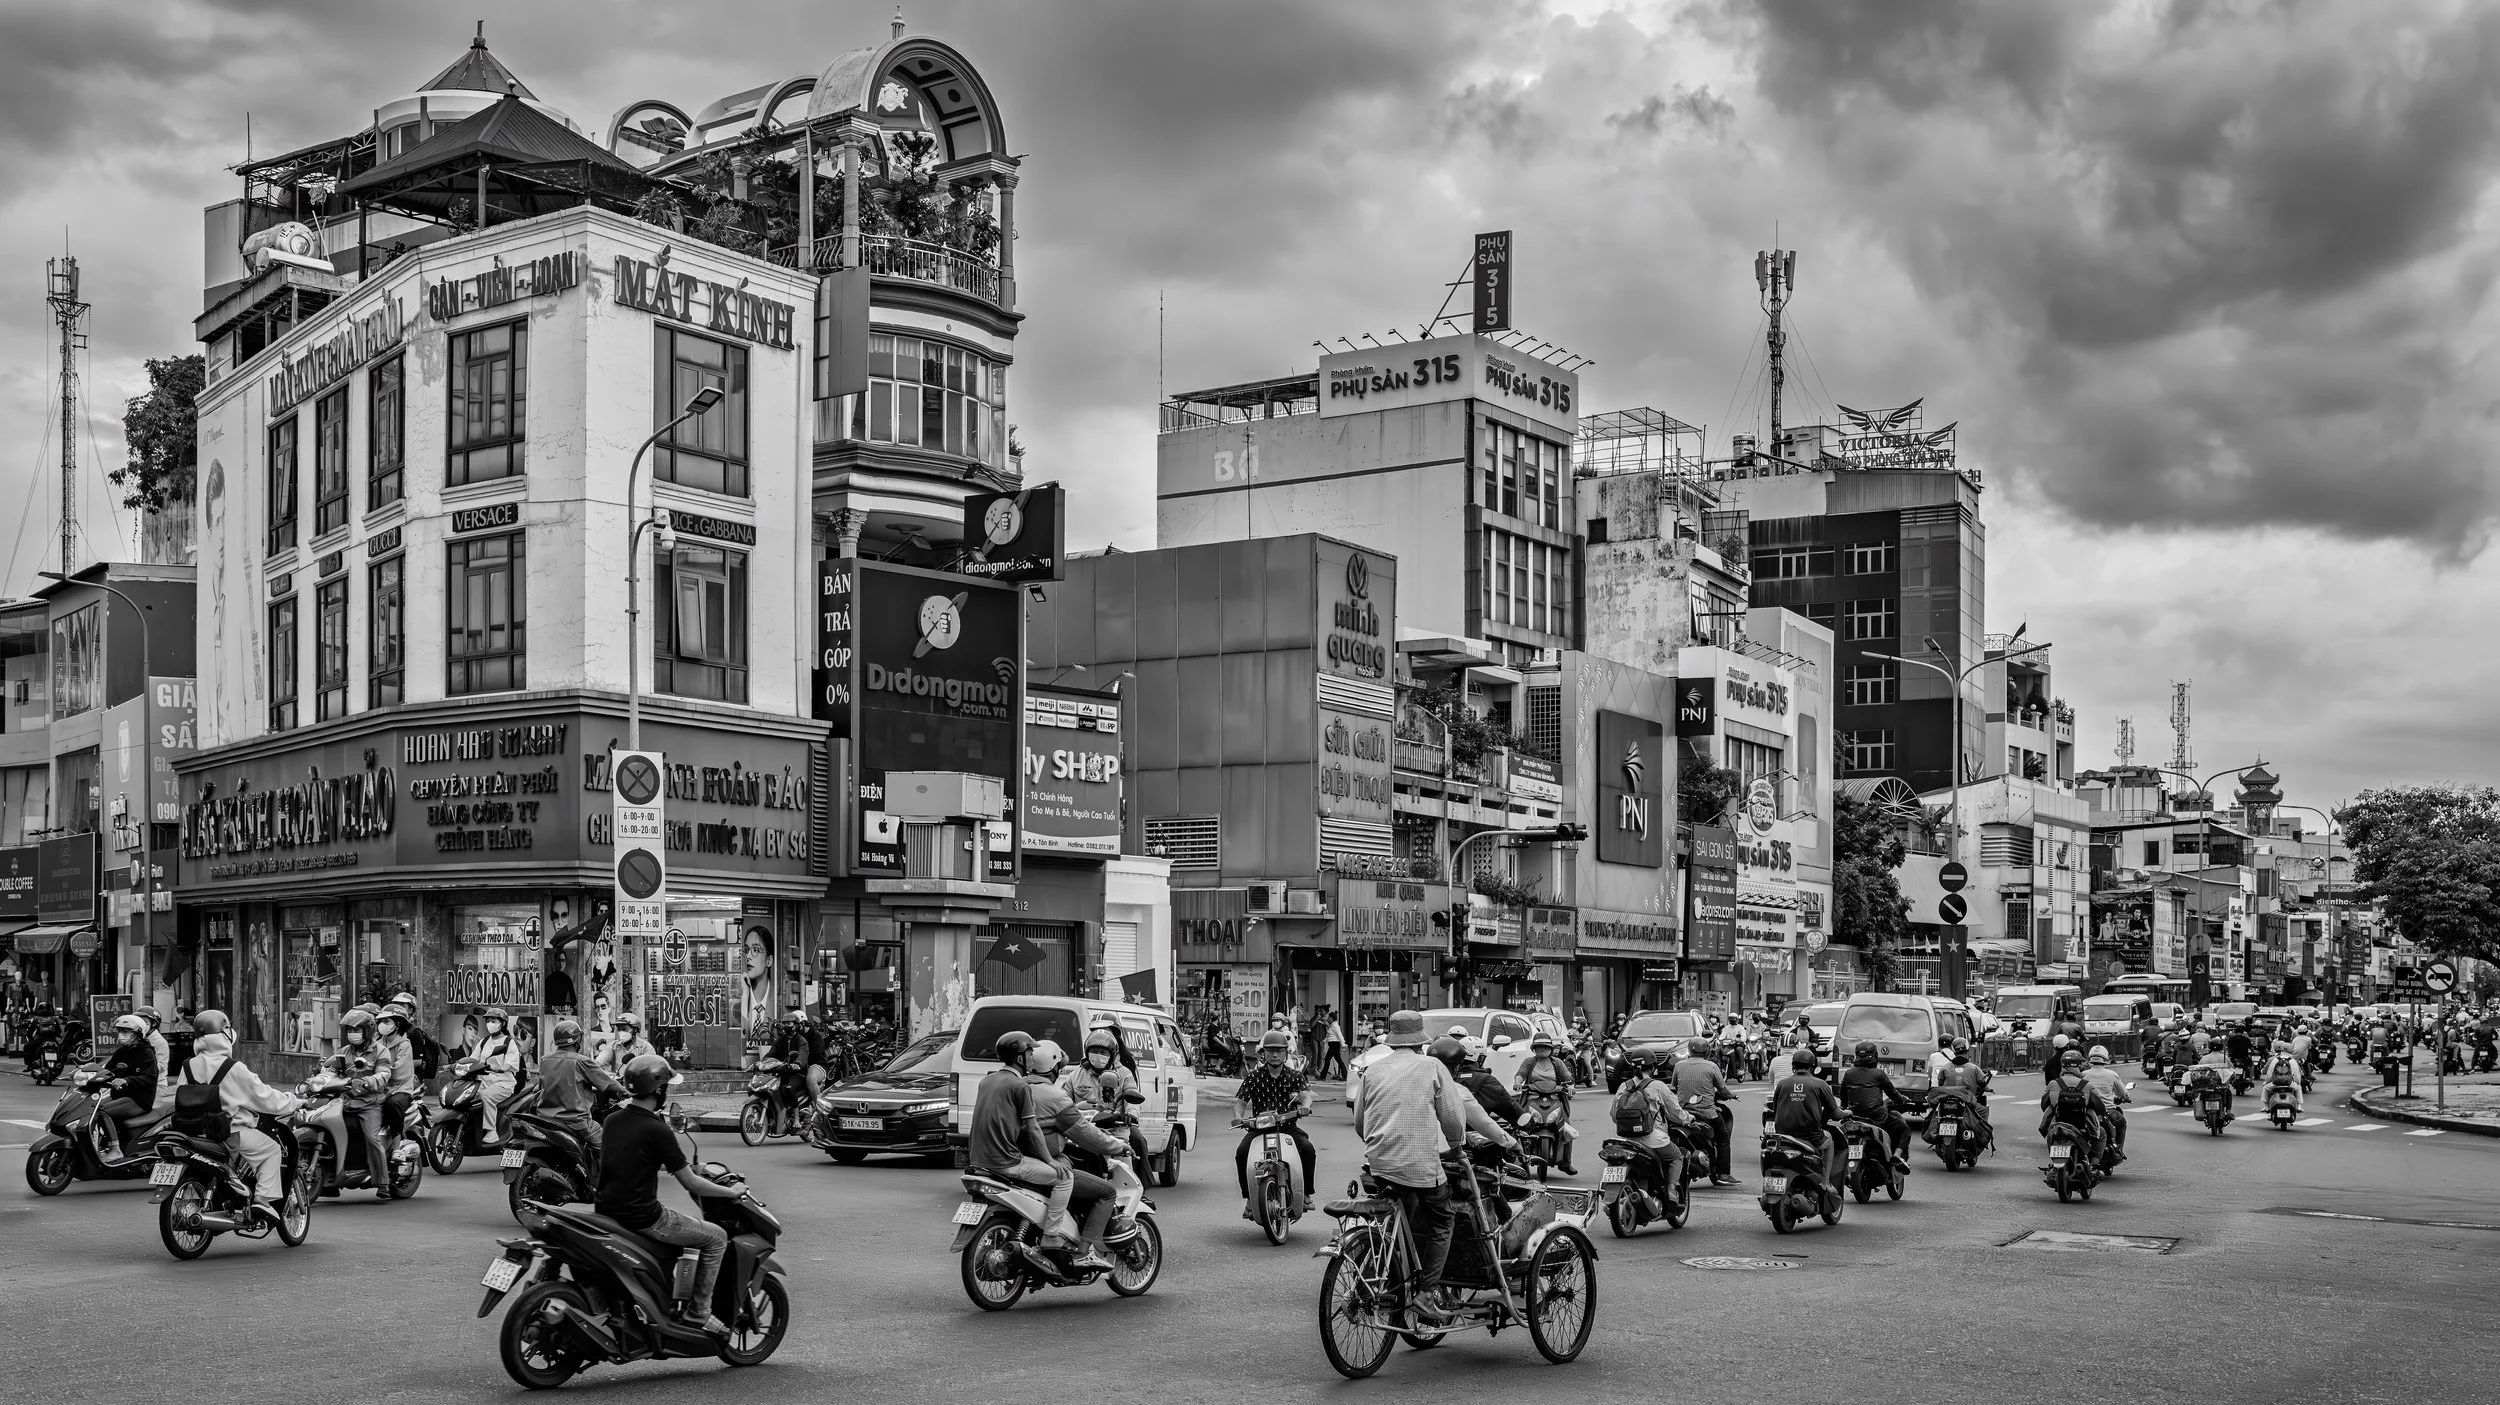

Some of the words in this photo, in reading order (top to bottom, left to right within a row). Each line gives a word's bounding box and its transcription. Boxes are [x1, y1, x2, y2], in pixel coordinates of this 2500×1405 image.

[1479, 235, 1506, 250] PHỤ
[1478, 249, 1506, 265] SẢN
[429, 276, 463, 323] CẬN
[531, 250, 578, 297] LOẠN
[614, 243, 698, 323] MẮT
[707, 276, 796, 350] KÍNH
[1330, 377, 1367, 400] PHỤ
[1371, 368, 1409, 393] SẢN
[1412, 354, 1461, 386] 315
[1331, 368, 1353, 378] Phòng
[1354, 364, 1375, 375] khám
[1485, 365, 1512, 397] PHỤ
[1512, 372, 1538, 402] SẢN
[1539, 375, 1571, 413] 315
[1839, 433, 1922, 451] VICTORIA
[455, 504, 512, 531] VERSACE
[694, 523, 700, 532] &
[700, 517, 754, 544] GABBANA
[369, 529, 398, 555] GUCCI
[824, 572, 851, 596] BÁN
[824, 603, 851, 632] TRẢ
[1334, 598, 1380, 637] minh
[824, 641, 851, 668] GÓP
[1327, 633, 1385, 679] quang
[866, 662, 1009, 708] Didongmoi
[1355, 665, 1376, 678] mobile
[157, 680, 197, 714] GIẶ
[826, 684, 850, 705] 0%
[1038, 701, 1055, 710] meiji
[1727, 680, 1747, 708] PHỤ
[1747, 681, 1766, 709] SẢN
[1766, 681, 1789, 716] 315
[1100, 722, 1116, 731] HiPP
[1681, 707, 1707, 725] PNJ
[160, 718, 196, 749] SẤ
[410, 773, 472, 800] CHUYÊN
[702, 760, 761, 806] HOÀN
[764, 763, 807, 810] HẢO
[1322, 762, 1351, 803] ĐIỆN
[860, 783, 883, 802] ĐIỆN
[1003, 795, 1014, 813] ỆN
[1039, 791, 1056, 802] Chính
[1031, 805, 1044, 815] Cho
[1091, 810, 1103, 820] Cao
[1619, 794, 1648, 842] PNJ
[620, 825, 659, 835] 16:00-20:00
[698, 818, 738, 855] KHÚC
[766, 828, 785, 857] BV
[789, 830, 807, 860] SG
[1770, 840, 1792, 872] 315
[15, 876, 34, 890] COFFEE
[1399, 884, 1426, 902] QUANG
[1013, 901, 1029, 911] 312
[1179, 918, 1245, 951] THOẠI
[447, 963, 474, 1004] BÁC
[95, 997, 130, 1014] GIẶT
[658, 987, 696, 1027] BÁC
[704, 988, 721, 1027] SĨ
[154, 1174, 175, 1184] 4276
[157, 1165, 178, 1174] 70-F1
